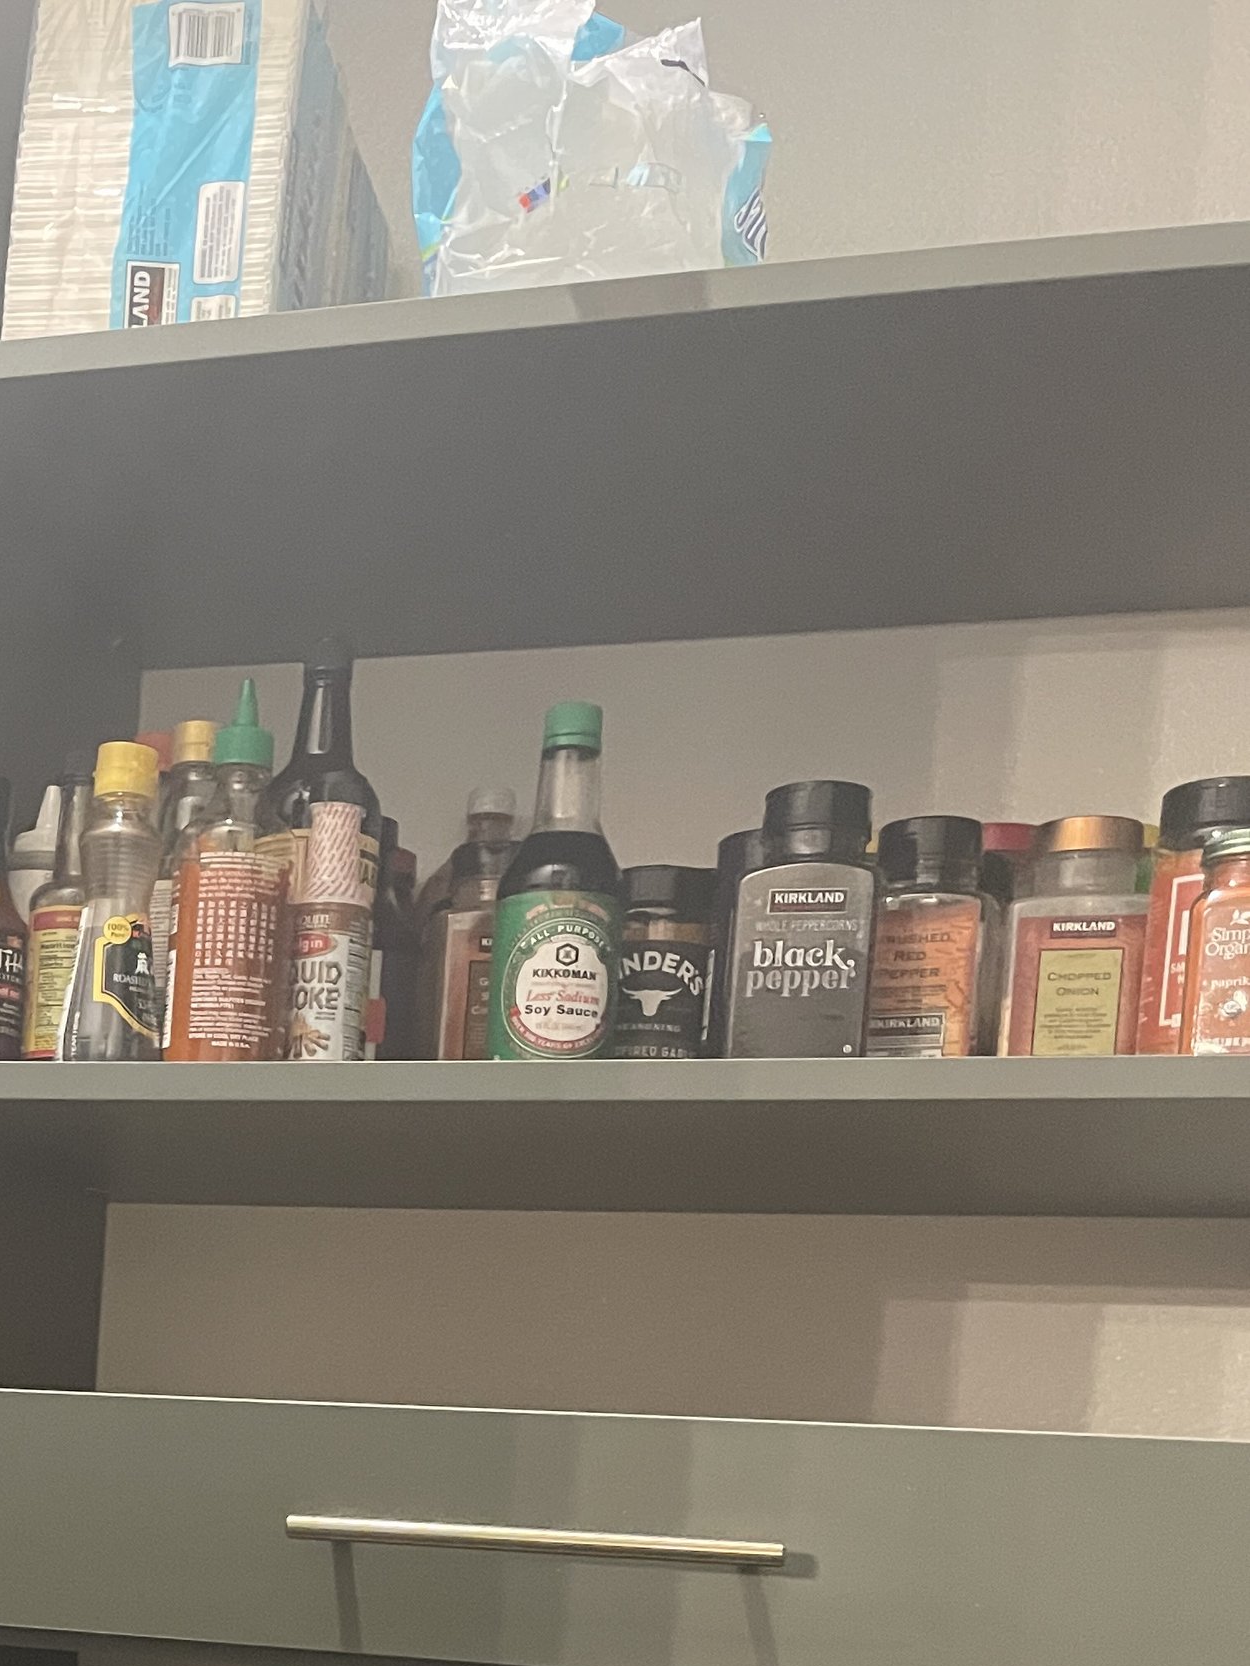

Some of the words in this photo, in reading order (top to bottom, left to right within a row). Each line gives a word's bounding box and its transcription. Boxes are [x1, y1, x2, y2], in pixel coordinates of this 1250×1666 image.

[774, 891, 845, 904] KIRKLAND
[1052, 921, 1116, 932] KIRKLAND
[753, 939, 856, 970] black
[894, 950, 927, 961] RED
[291, 960, 342, 985] UID
[532, 968, 597, 981] KIKKOMAN
[1047, 971, 1112, 981] CHOPPED
[745, 969, 857, 998] pepper
[526, 990, 552, 1002] Less
[555, 989, 600, 1005] Sodium
[1056, 986, 1099, 997] ONION
[524, 1004, 551, 1017] Soy
[556, 1004, 599, 1018] Sauce
